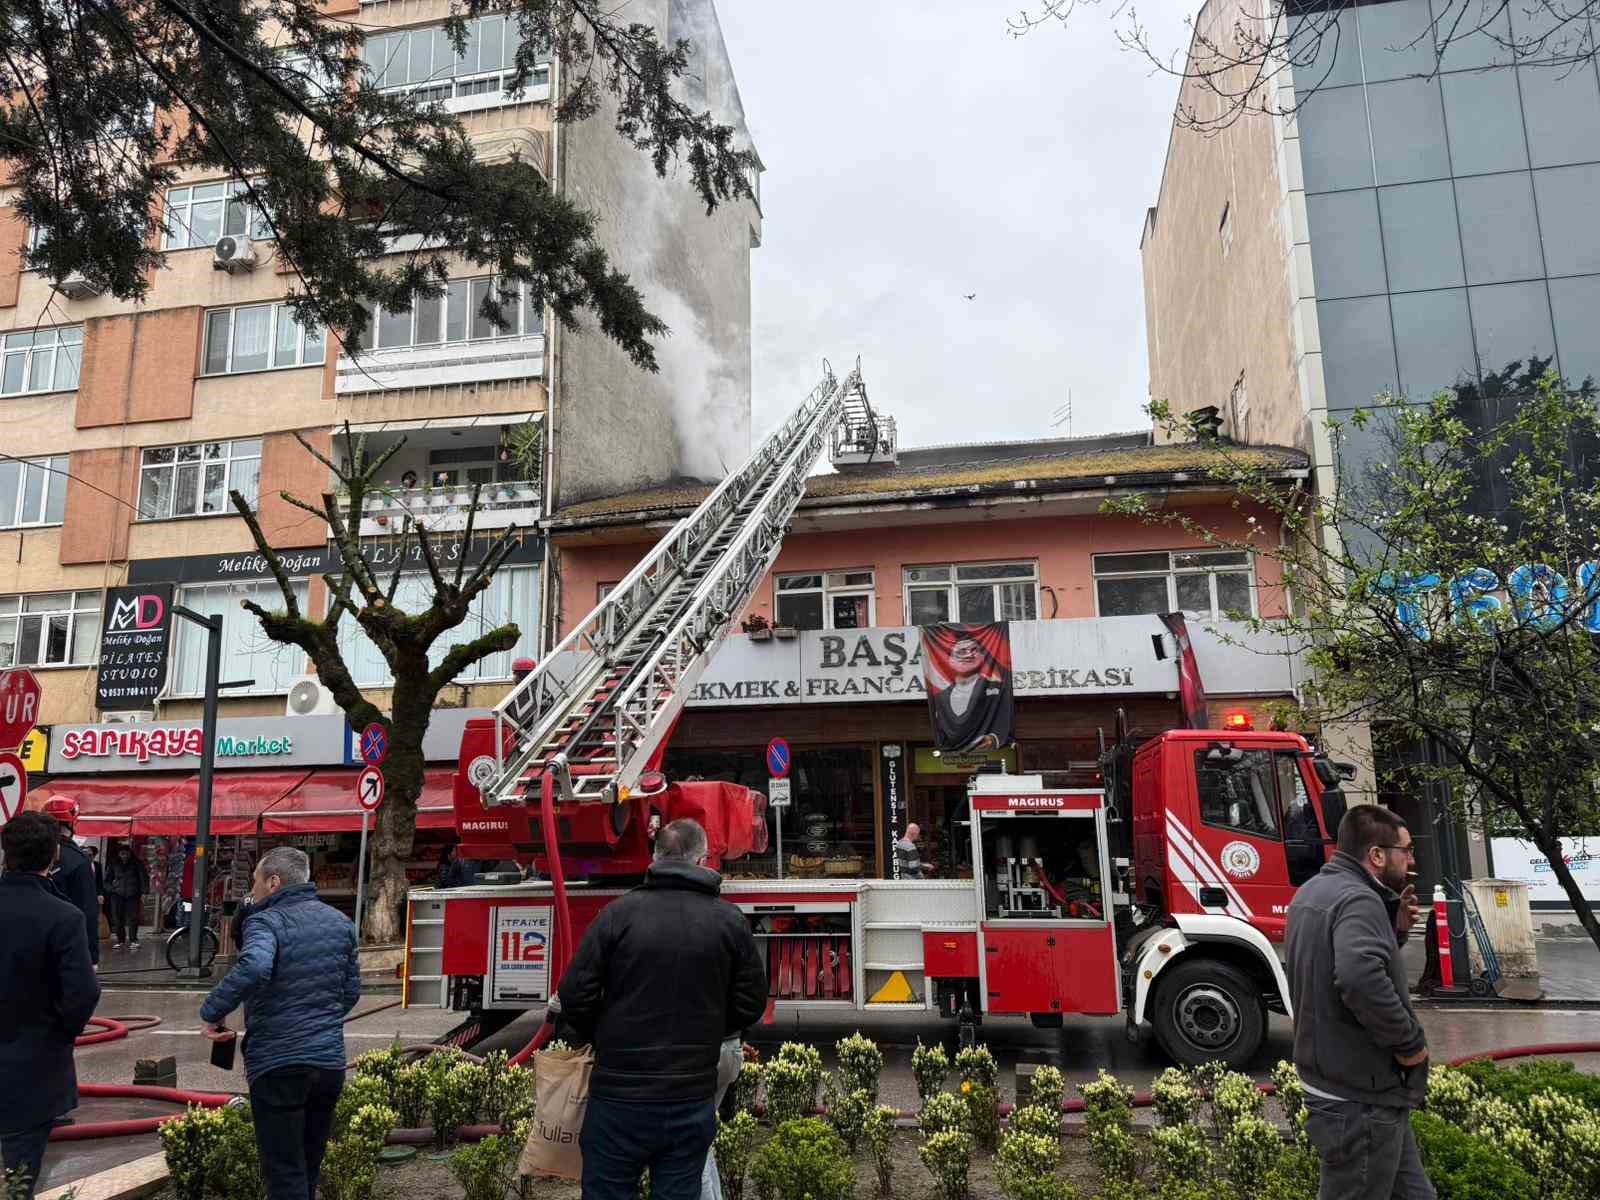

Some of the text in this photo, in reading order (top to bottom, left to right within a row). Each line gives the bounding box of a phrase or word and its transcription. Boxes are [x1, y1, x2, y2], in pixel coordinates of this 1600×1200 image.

[218, 555, 268, 573] Melike
[101, 651, 163, 665] PİLATES
[101, 667, 159, 681] STUDIO
[784, 681, 799, 697] &
[806, 675, 927, 697] FRANCA
[5, 692, 36, 724] UR
[216, 736, 293, 758] Market
[1008, 798, 1065, 807] MAGIRUS
[501, 931, 547, 961] 112
